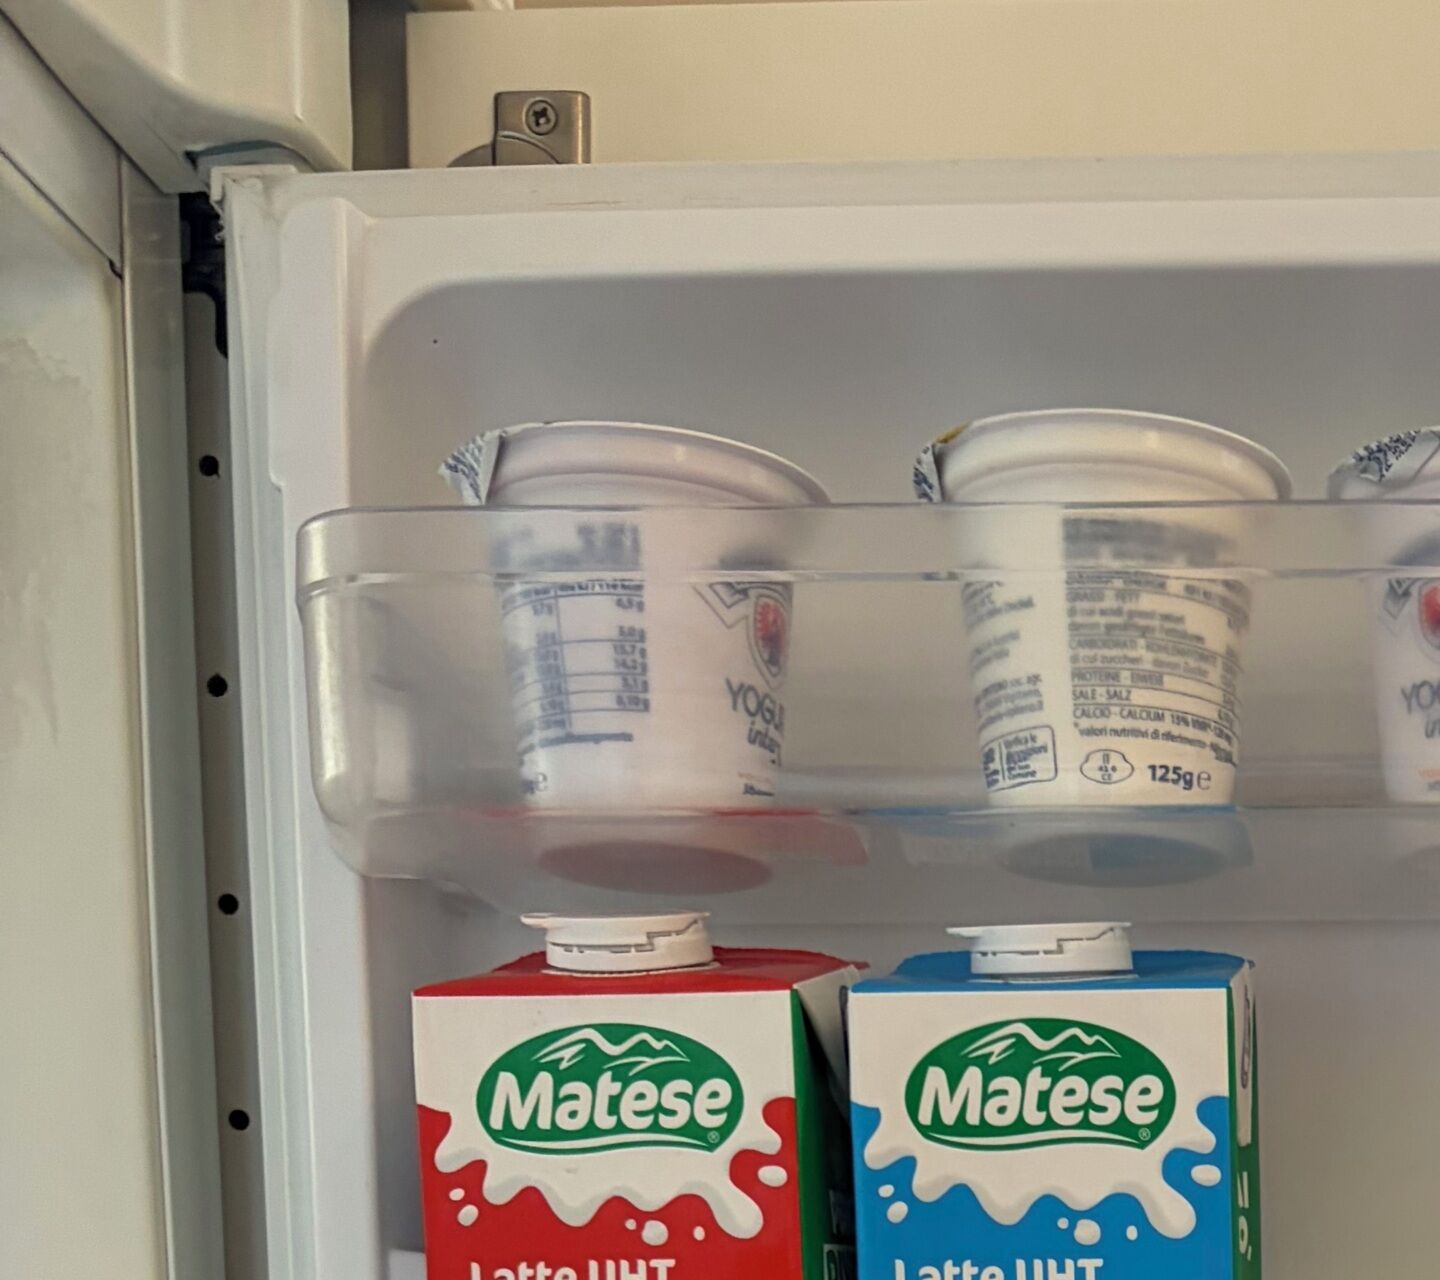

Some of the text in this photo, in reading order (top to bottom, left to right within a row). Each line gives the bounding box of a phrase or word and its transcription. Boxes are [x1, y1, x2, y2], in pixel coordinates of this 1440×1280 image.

[1148, 765, 1193, 791] 125g
[489, 1071, 732, 1131] Matese
[918, 1065, 1164, 1127] Matese
